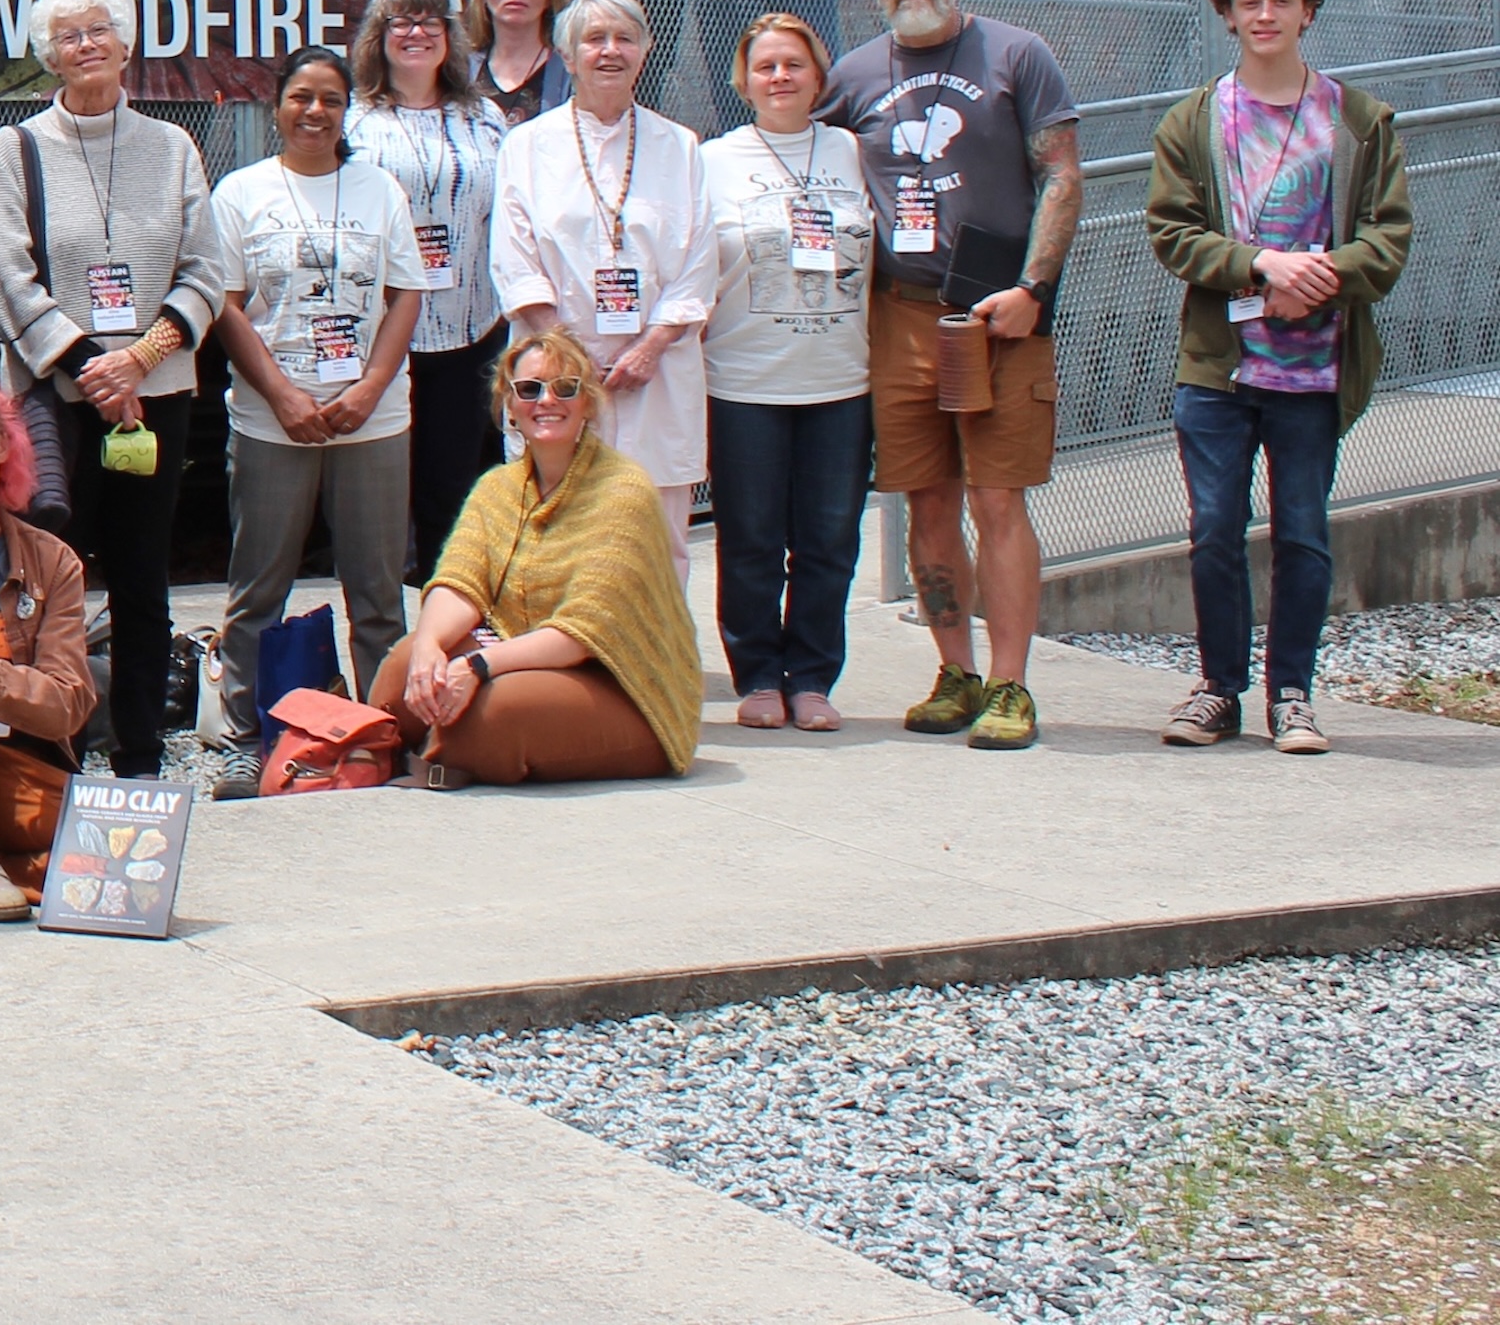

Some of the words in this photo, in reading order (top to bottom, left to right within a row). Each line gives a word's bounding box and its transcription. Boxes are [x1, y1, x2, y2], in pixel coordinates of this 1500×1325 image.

[875, 72, 938, 112] REVOLUTION
[939, 74, 984, 101] CYCLES
[749, 168, 847, 192] Sustain
[932, 172, 962, 192] CULT
[267, 210, 365, 230] Sustain
[92, 295, 134, 308] 2025
[597, 299, 640, 311] 2025
[317, 345, 360, 360] 2025
[73, 785, 126, 809] WILD
[128, 789, 182, 814] CLAY
